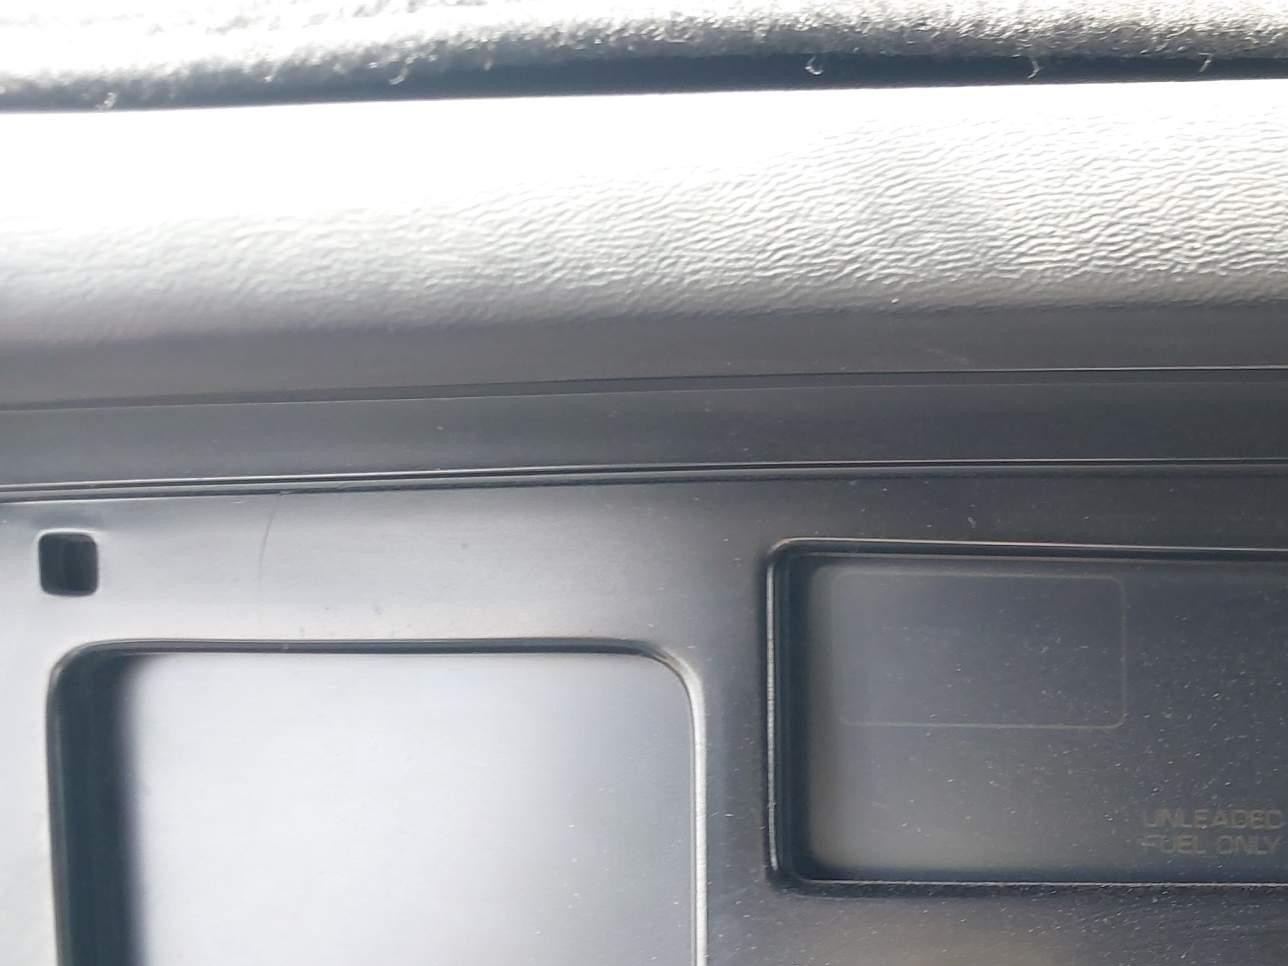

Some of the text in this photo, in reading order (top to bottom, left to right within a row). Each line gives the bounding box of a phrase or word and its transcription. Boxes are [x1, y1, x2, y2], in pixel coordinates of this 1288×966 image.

[1143, 808, 1283, 830] UNLEADED
[1143, 834, 1283, 855] FUEL ONLY
